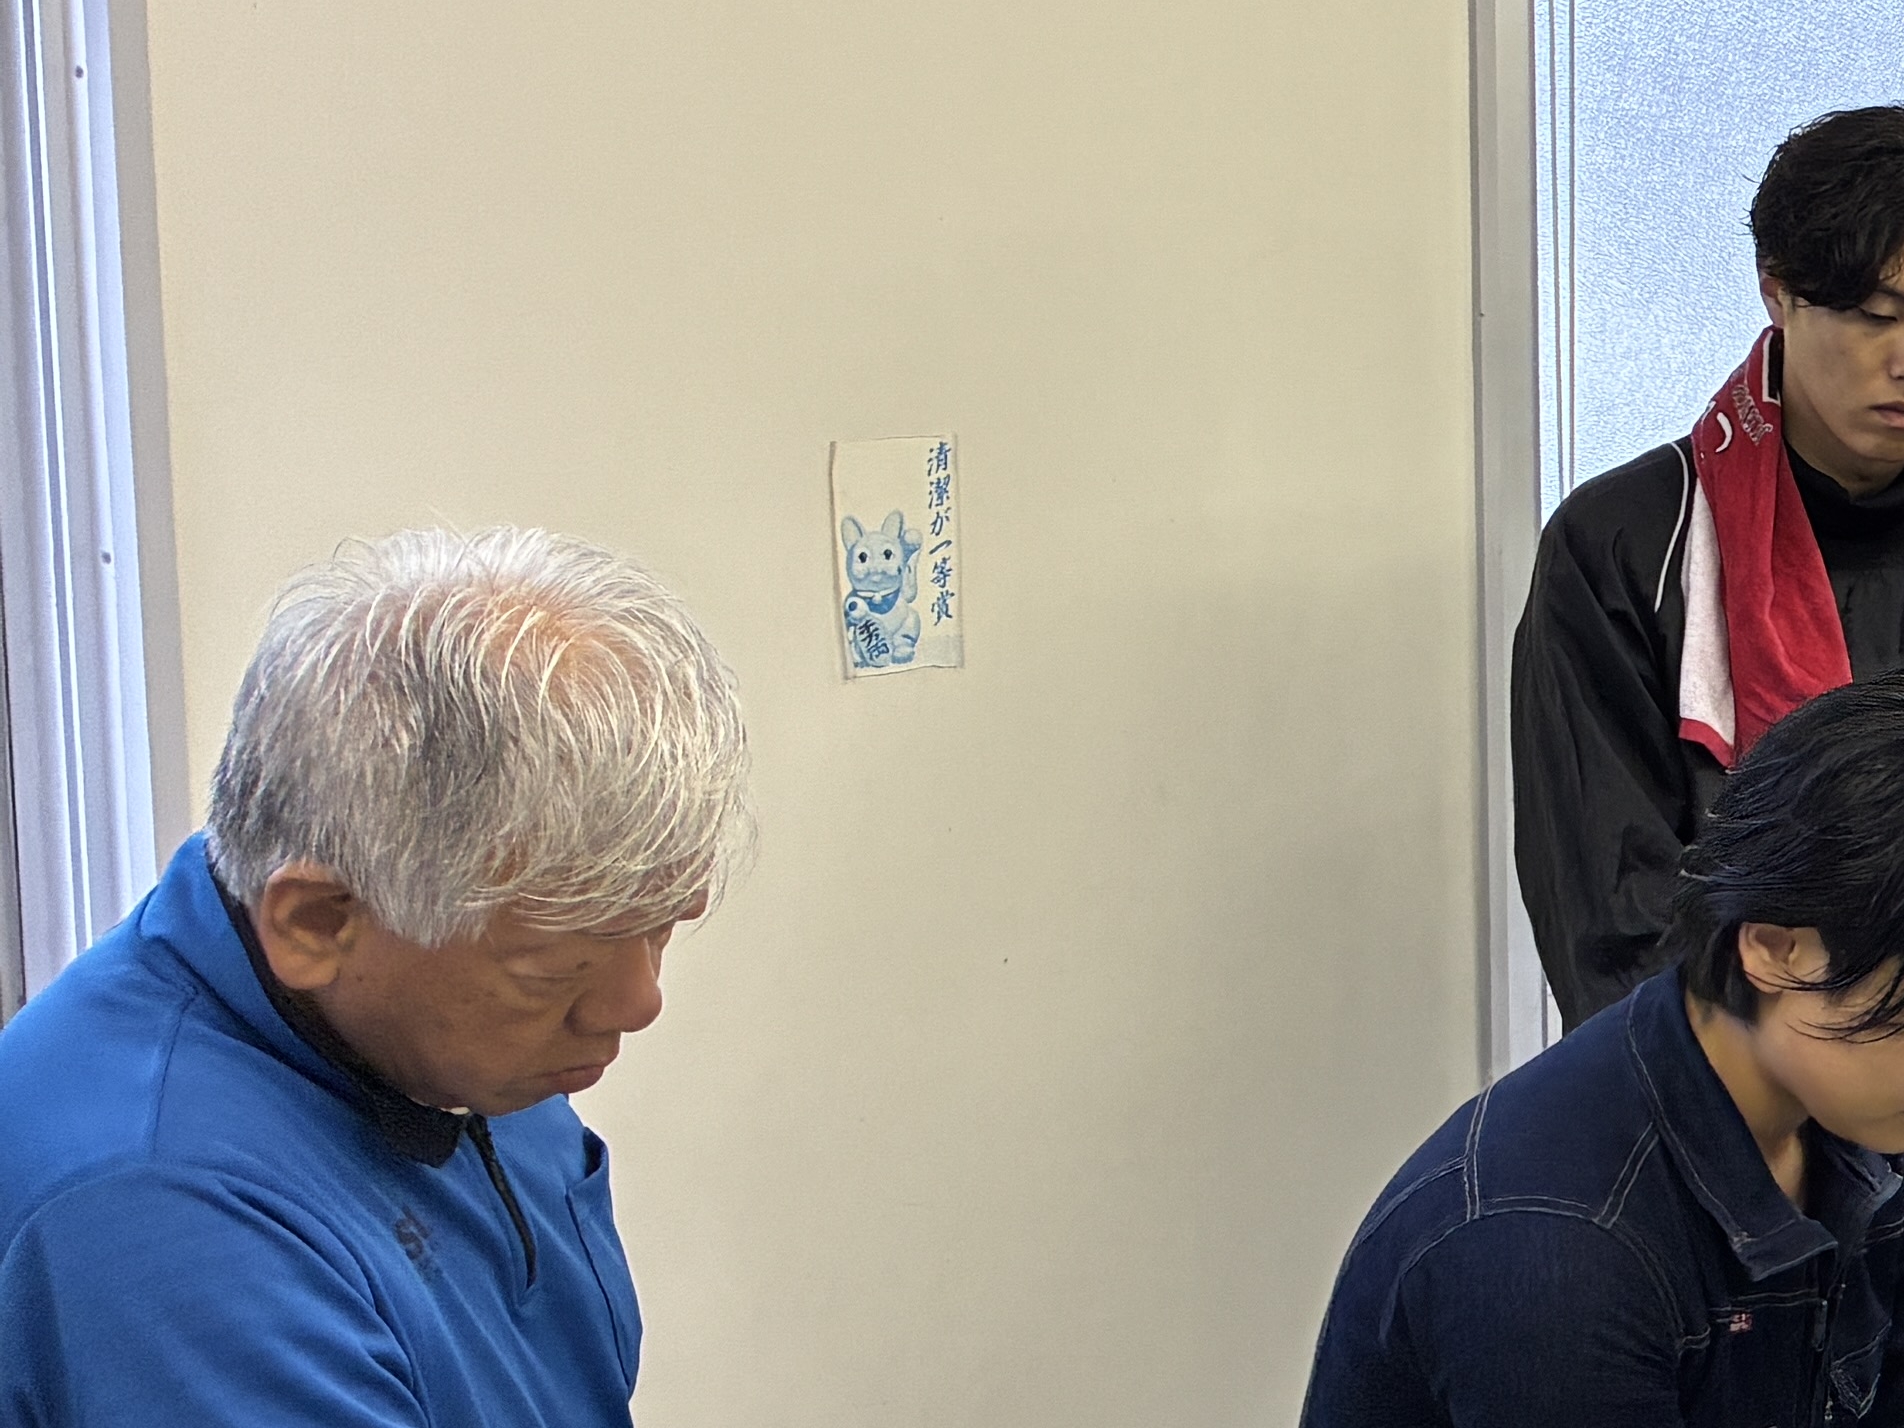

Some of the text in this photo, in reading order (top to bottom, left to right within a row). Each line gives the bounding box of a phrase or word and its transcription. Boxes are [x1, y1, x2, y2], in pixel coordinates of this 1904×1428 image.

[927, 441, 956, 626] 清潔が一等賞
